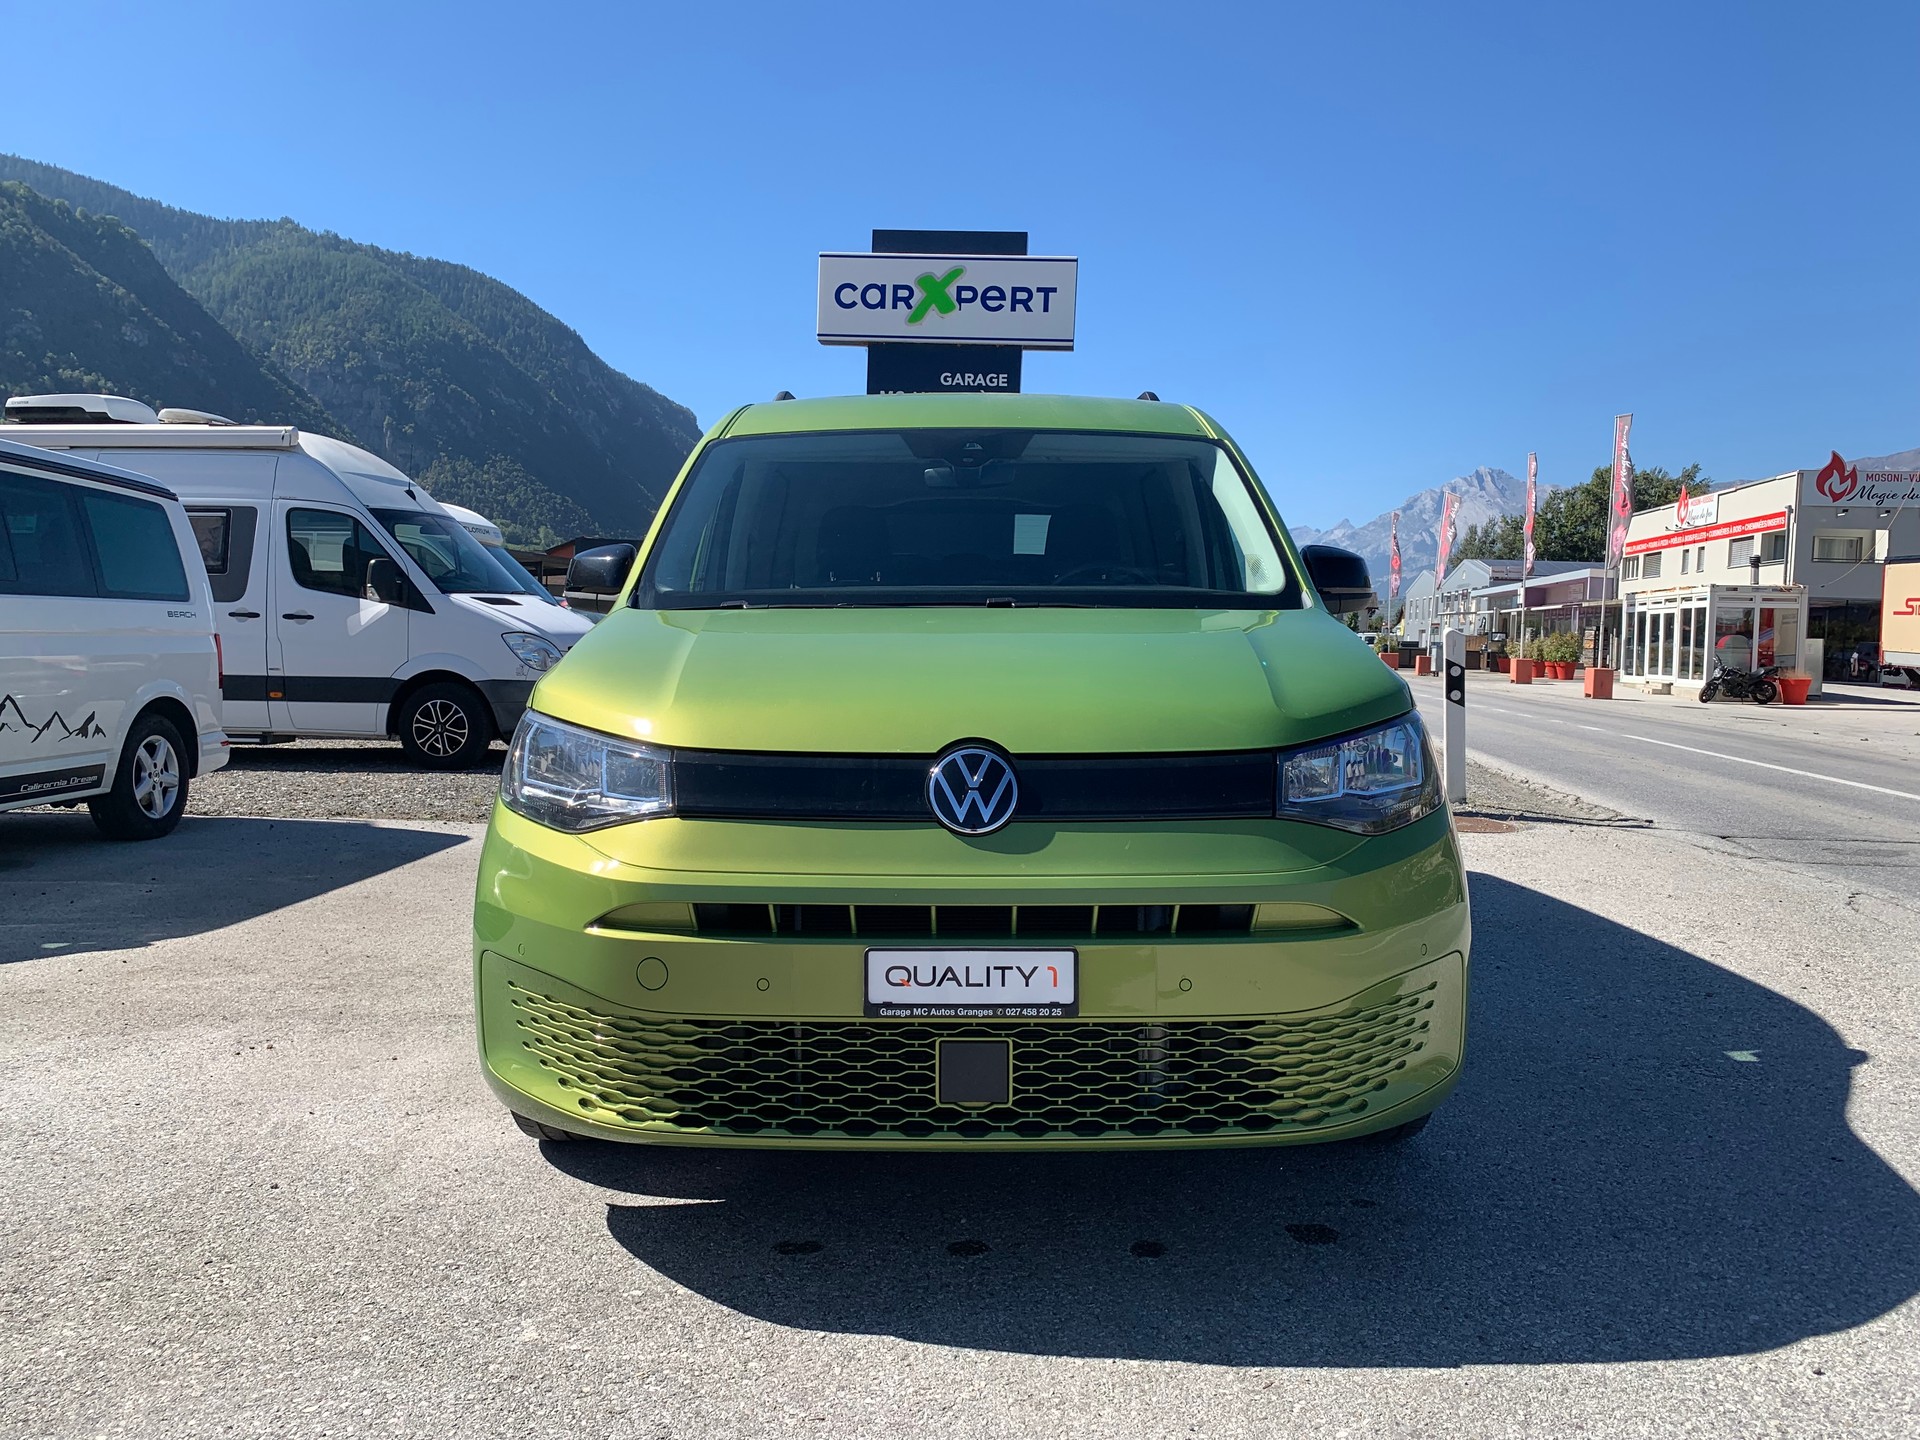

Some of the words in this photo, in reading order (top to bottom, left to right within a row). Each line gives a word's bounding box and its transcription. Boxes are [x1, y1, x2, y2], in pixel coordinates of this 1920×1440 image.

[940, 372, 1008, 387] GARAGE
[1846, 484, 1899, 506] Magie
[167, 610, 197, 619] BEACH
[20, 779, 68, 793] California
[70, 775, 98, 785] Dream
[885, 965, 1039, 988] QUALITY
[879, 1007, 911, 1017] Garage
[913, 1007, 929, 1016] MC
[930, 1007, 956, 1016] Autos
[957, 1007, 994, 1017] Granges
[1005, 1007, 1021, 1016] 027
[1021, 1007, 1038, 1016] 458
[1039, 1007, 1050, 1016] 20
[1051, 1007, 1062, 1016] 25
